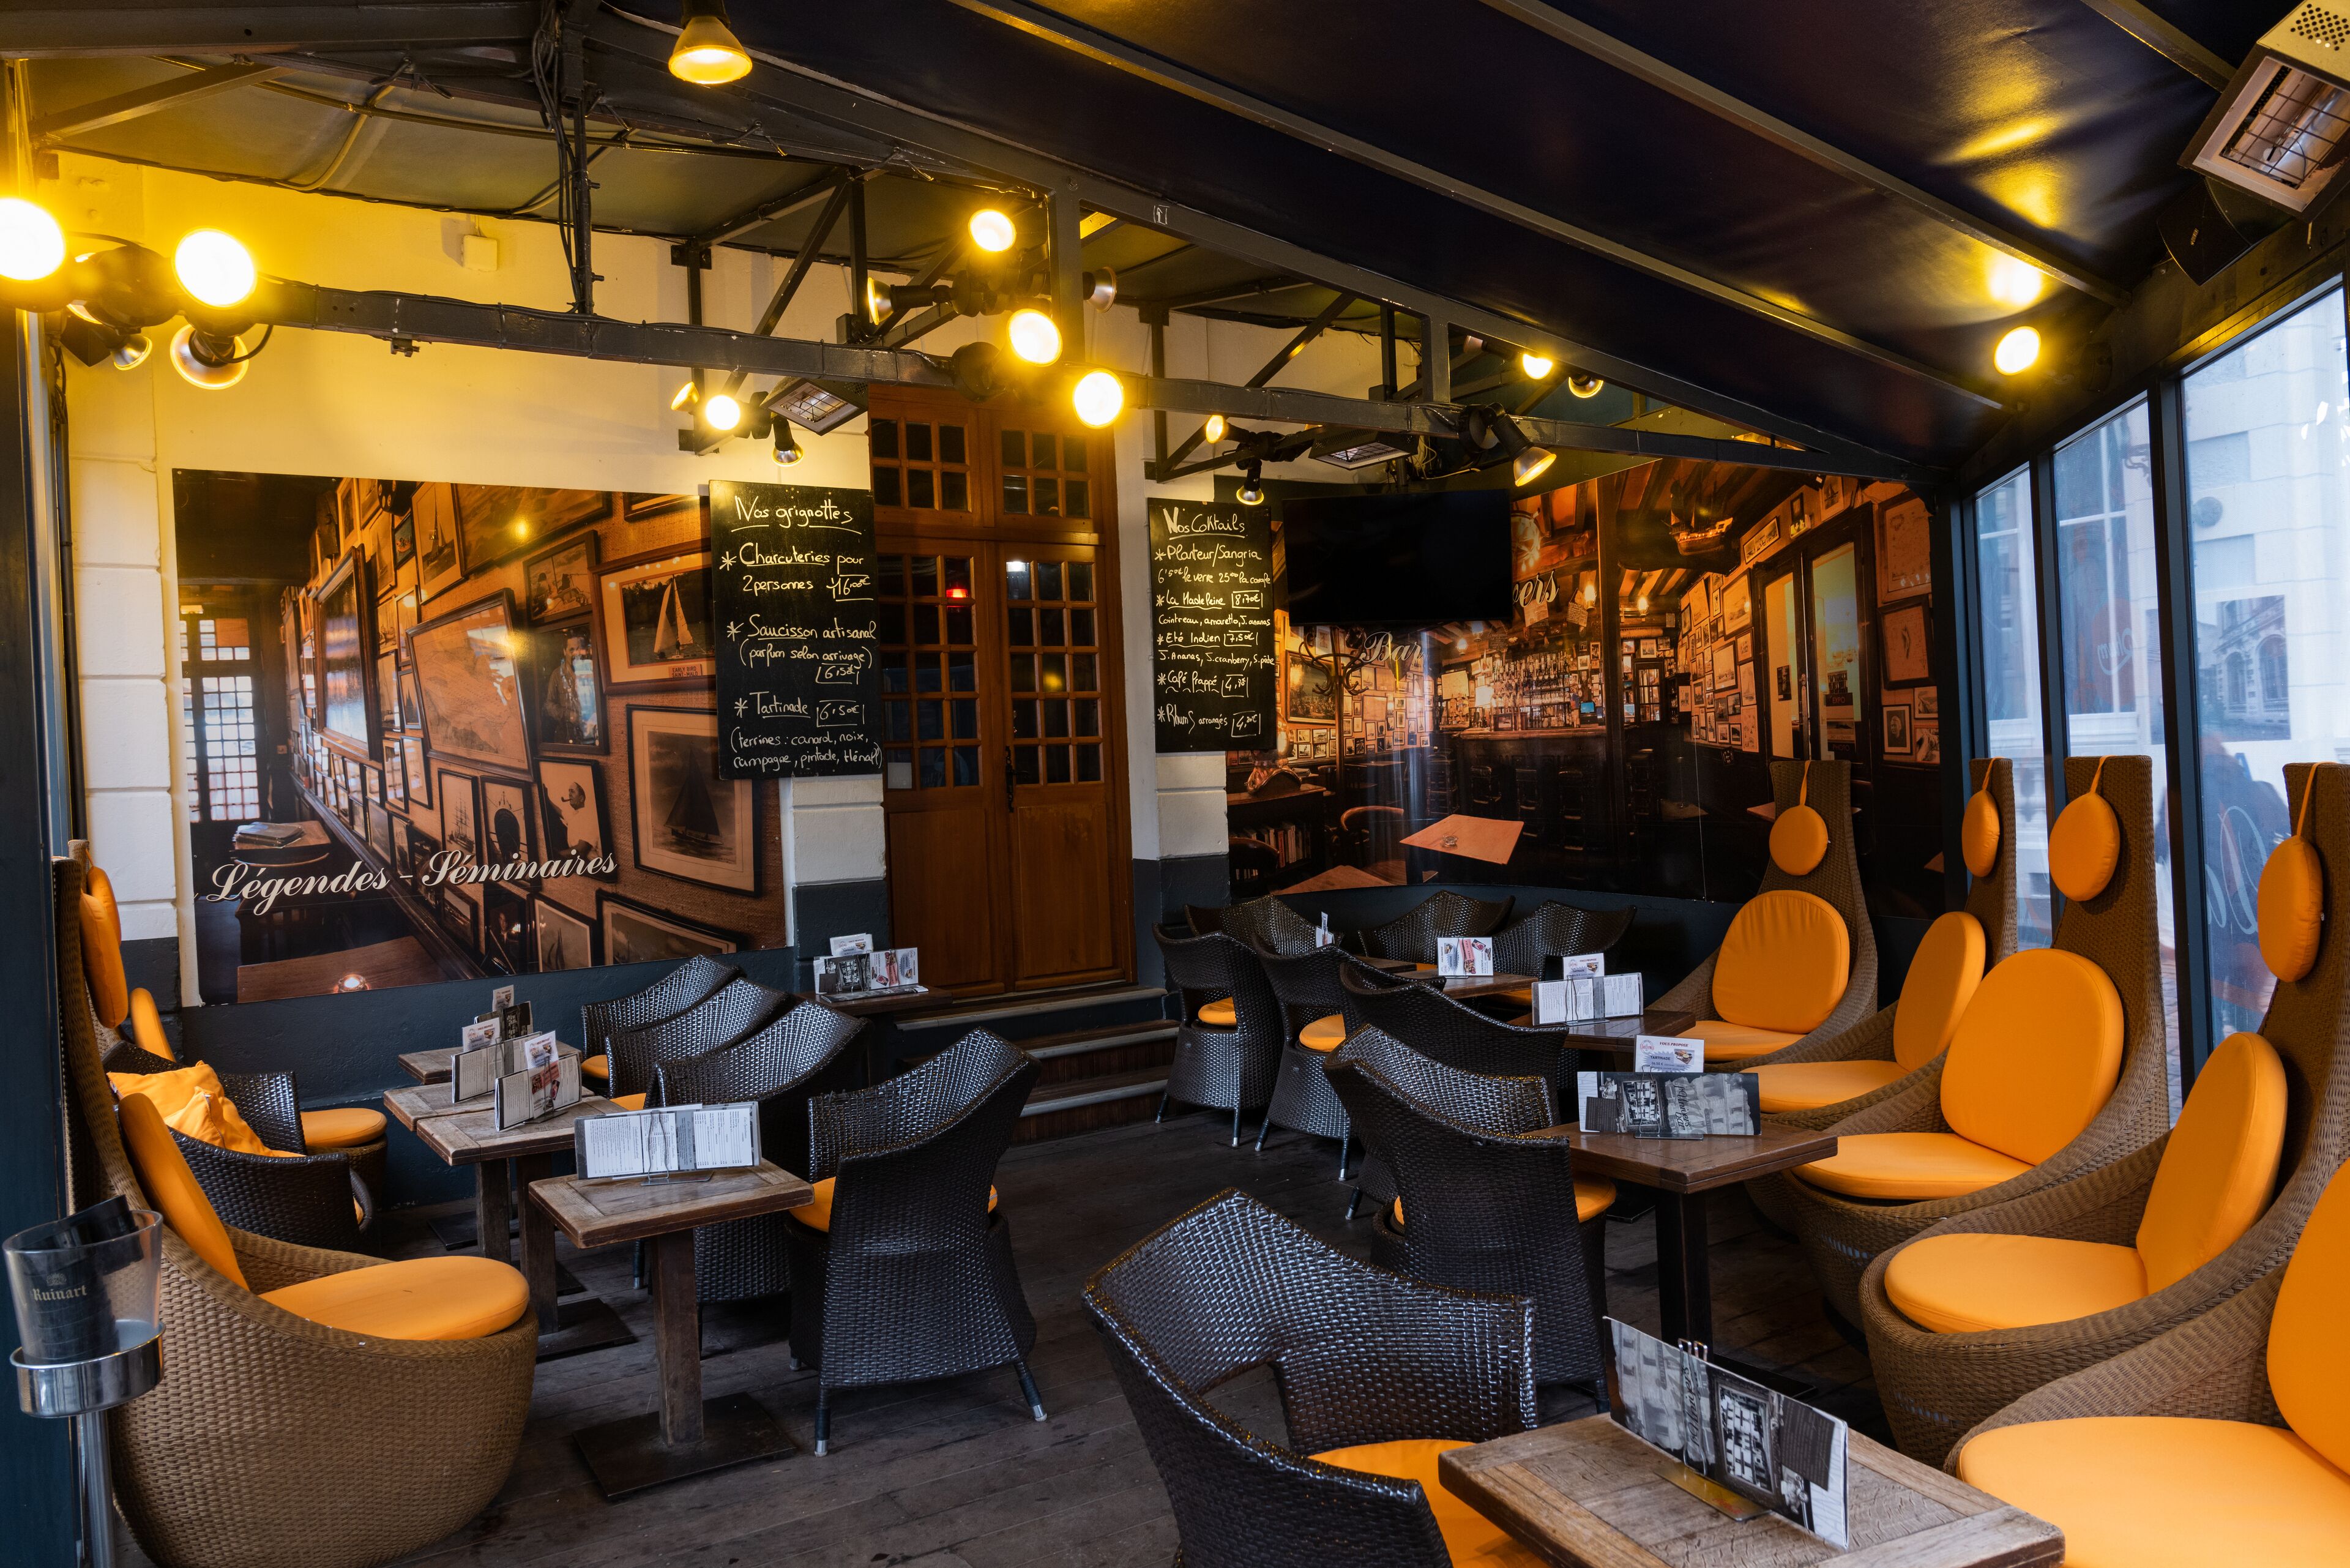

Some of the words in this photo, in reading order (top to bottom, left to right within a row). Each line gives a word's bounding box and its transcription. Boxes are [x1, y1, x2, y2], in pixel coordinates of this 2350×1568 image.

[735, 496, 769, 521] Nos
[776, 499, 854, 528] grignottes
[1163, 507, 1190, 534] Nos
[739, 542, 830, 564] Charcuteries
[837, 555, 864, 575] pour
[1182, 566, 1192, 583] le
[1193, 574, 1214, 583] verre
[1239, 572, 1249, 583] la
[1250, 573, 1271, 588] carafe
[1166, 589, 1179, 605] La
[1183, 591, 1226, 606] Madeleine
[748, 614, 818, 638] Saucisson
[823, 617, 876, 640] artisanal
[1191, 632, 1220, 643] Indien
[790, 646, 819, 659] selon
[1359, 631, 1424, 663] Bar
[1168, 670, 1188, 688] Café
[1192, 671, 1217, 693] frappé
[749, 691, 808, 715] Tartinade
[1199, 714, 1228, 730] arrangés
[206, 861, 390, 916] Légendes
[422, 849, 617, 886] Séminaires
[32, 1285, 88, 1302] Ruinart
